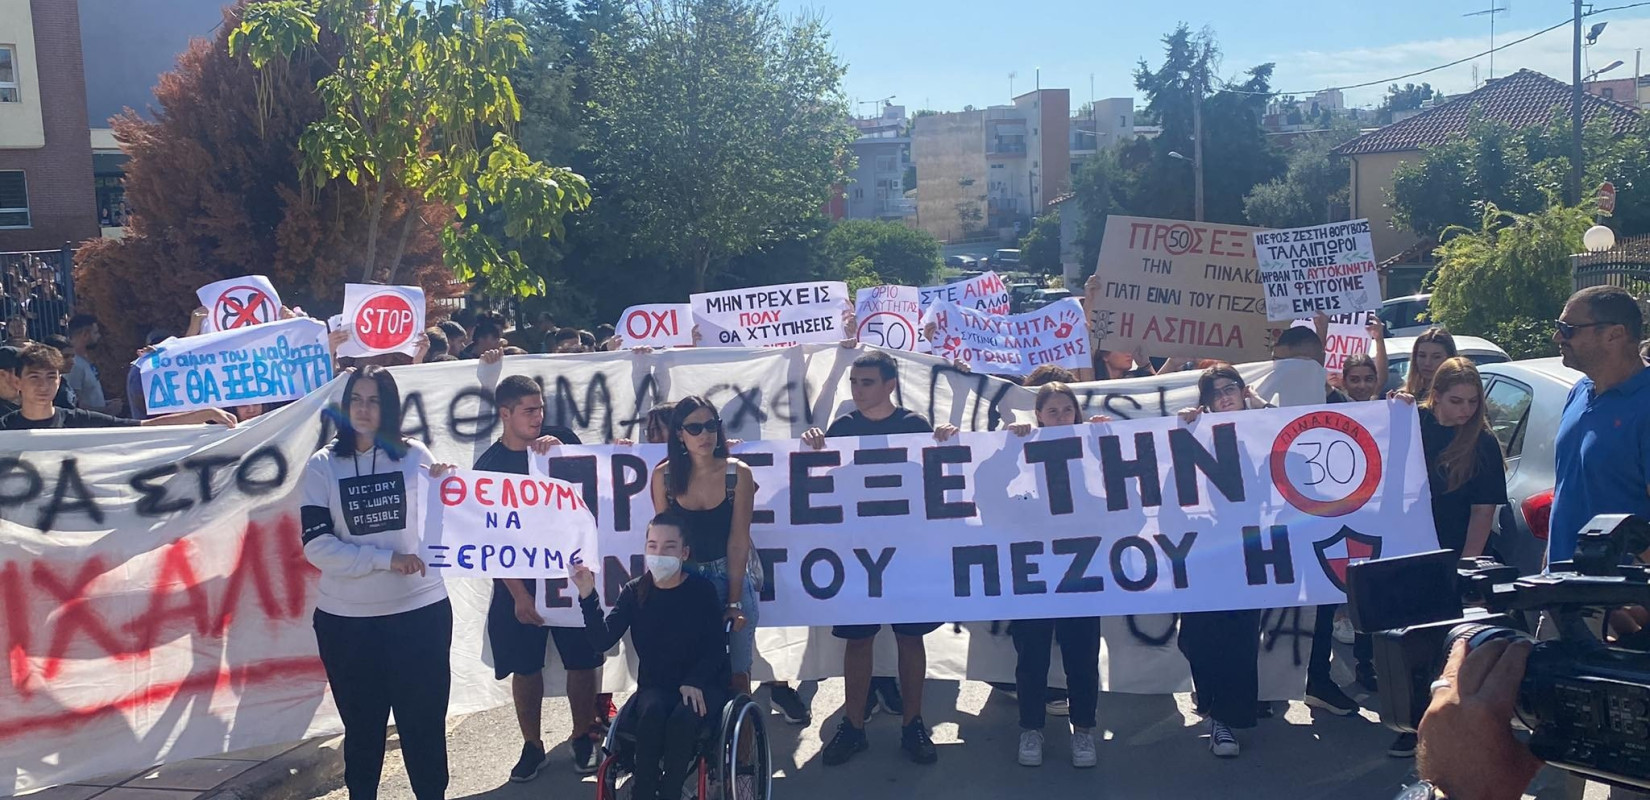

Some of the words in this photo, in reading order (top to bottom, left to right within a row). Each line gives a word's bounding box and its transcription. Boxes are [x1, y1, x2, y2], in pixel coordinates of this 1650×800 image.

[1129, 222, 1258, 258] ΠΡΟΣΕΞ
[1168, 229, 1191, 249] 50
[1256, 231, 1290, 245] ΝΕΦΟΣ
[1292, 227, 1328, 242] ΖΕΣΤΗ
[1329, 221, 1371, 238] ΘΟΡΥΒΟΣ
[1267, 237, 1357, 260] ΤΑΛΑΙΠΩΡΟΙ
[1142, 257, 1172, 274] ΤΗΝ
[1262, 270, 1291, 284] ΗΡΘΑΝ
[1291, 269, 1306, 281] ΤΑ
[1307, 261, 1375, 280] ΑΥΤΟΚΙΝΗΤΑ
[1291, 255, 1337, 269] ΓΟΝΕΙΣ
[706, 294, 742, 314] ΜΗΝ
[745, 285, 831, 310] ΤΡΕΧΕΙΣ
[872, 285, 898, 299] ΟΡΙΟ
[963, 274, 1005, 300] ΑΙΜΑ
[1105, 281, 1140, 301] ΓΙΑΤΙ
[1147, 285, 1181, 305] ΕΙΝΑΙ
[1189, 291, 1215, 309] ΤΟΥ
[1268, 283, 1288, 298] ΚΑΙ
[1294, 275, 1364, 296] ΦΕΥΓΟΥΜΕ
[858, 300, 918, 313] ΤΑΧΥΤΗΤΑΣ
[975, 293, 1008, 310] ΑΛΛΟ
[1292, 295, 1341, 313] ΕΜΕΙΣ
[360, 307, 413, 334] STOP
[626, 309, 679, 340] ΟΧΙ
[719, 330, 741, 344] ΘΑ
[747, 316, 835, 340] ΧΤΥΠΗΣΕΙΣ
[739, 309, 782, 327] ΠΟΛΥ
[936, 310, 948, 330] Η
[960, 314, 1057, 336] ΤΑΧΥΤΗΤΑ
[1120, 312, 1134, 338] Η
[1142, 315, 1244, 349] ΑΣΠΙΔΑ
[867, 322, 906, 350] 50
[1004, 336, 1041, 349] ΑΛΛΑ
[1325, 335, 1369, 354] ΟΝΤΑΙ
[219, 349, 248, 363] του
[1028, 338, 1087, 366] ΕΠΙΣΗΣ
[148, 370, 184, 409] ΔΕ
[186, 368, 222, 405] ΘΑ
[1280, 414, 1360, 445] ΠΙΝΑΚΙΔΑ
[1296, 440, 1355, 486] 30
[129, 445, 288, 516] ΣΤΟ
[548, 445, 977, 531] ΠΡΕΞΕ
[1024, 422, 1246, 515] ΤΗΝ
[348, 501, 359, 511] IS
[363, 495, 400, 508] LWAYS
[440, 476, 588, 511] ΘΕΛΟΥΜ
[486, 511, 521, 529] ΝΑ
[428, 545, 583, 571] ΞΕΡΟΥΜΕ
[754, 546, 897, 602] ΤΟΥ
[952, 531, 1198, 597] ΠΕΖΟΥ
[1241, 524, 1295, 586] Η
